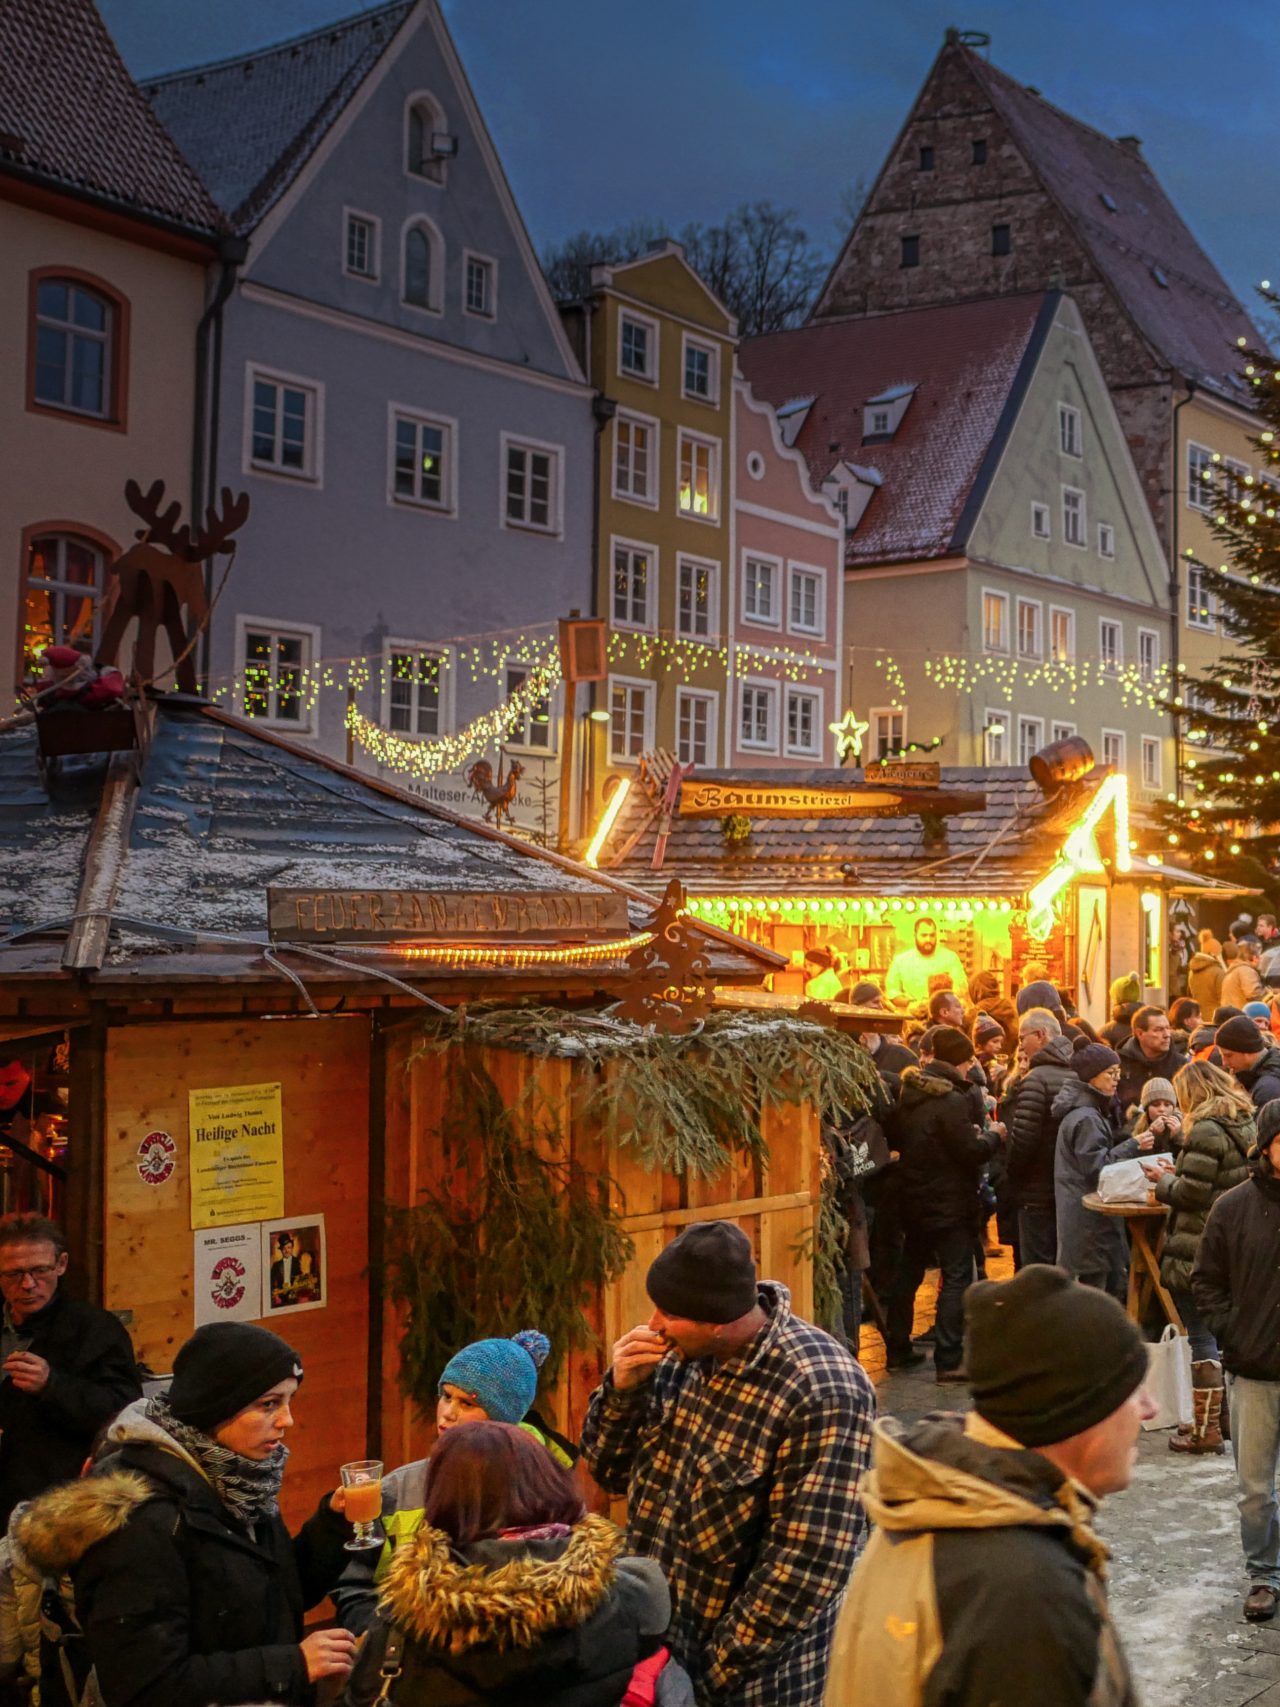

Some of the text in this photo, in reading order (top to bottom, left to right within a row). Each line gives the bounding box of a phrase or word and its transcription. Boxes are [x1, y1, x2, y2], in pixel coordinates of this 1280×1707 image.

[408, 784, 532, 807] Malteser-Apeke
[694, 787, 852, 807] Baumstriezel
[196, 1121, 276, 1143] Heilige Nacht
